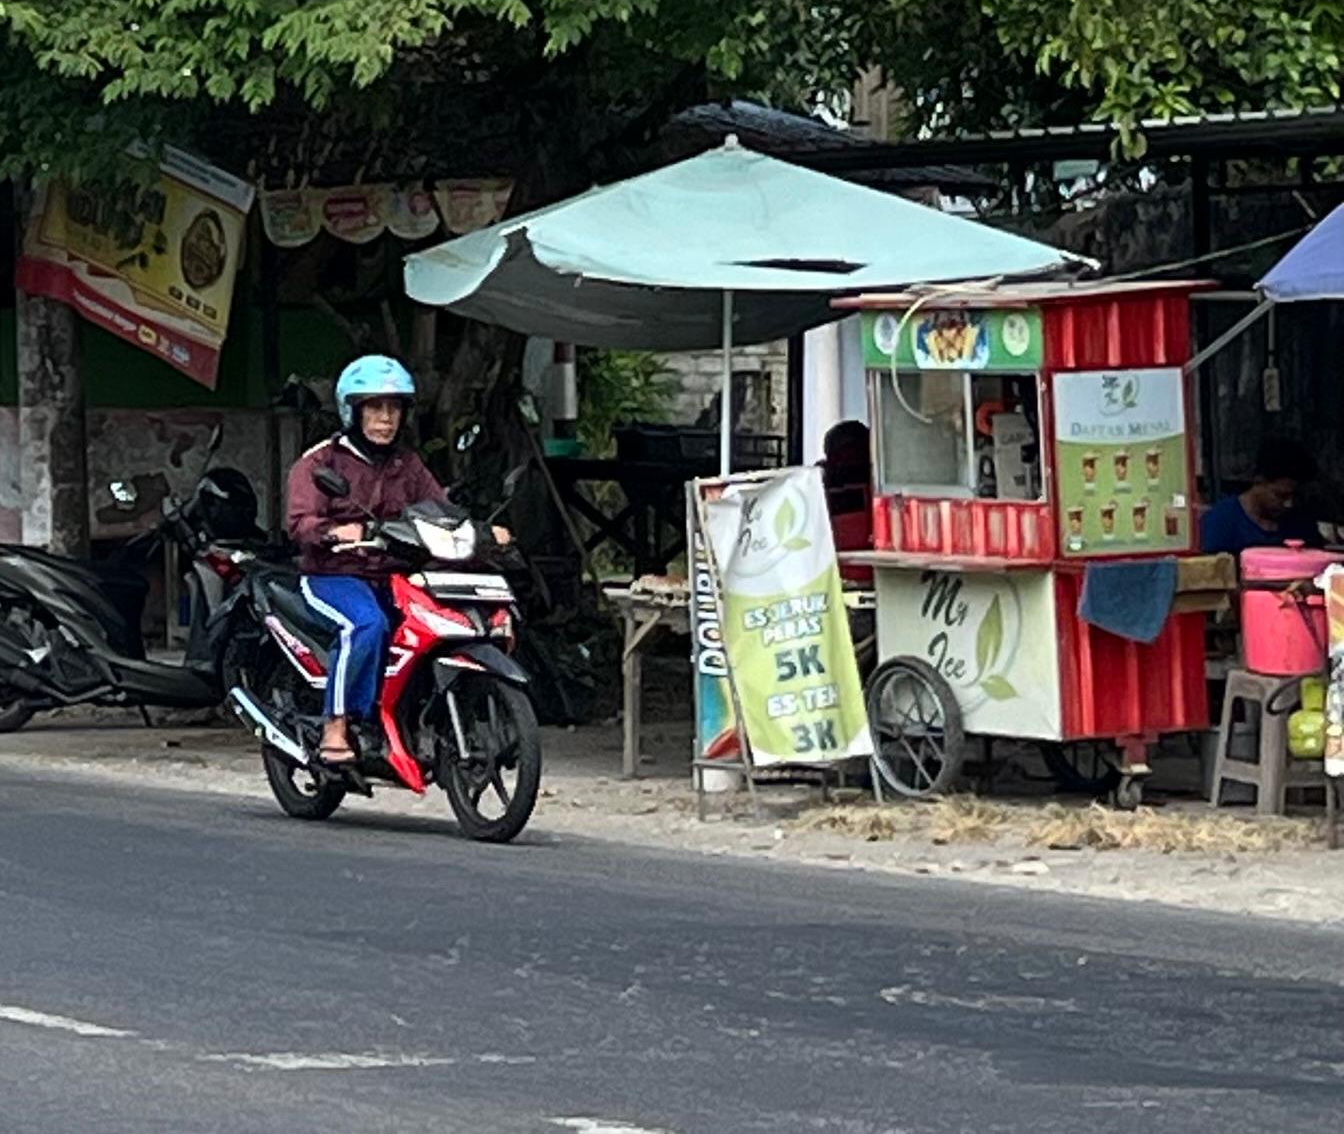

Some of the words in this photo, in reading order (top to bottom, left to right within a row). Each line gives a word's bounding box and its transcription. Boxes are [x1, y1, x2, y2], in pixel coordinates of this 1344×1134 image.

[743, 608, 769, 630] ES
[768, 594, 829, 622] JERUK
[921, 570, 968, 627] My
[762, 619, 823, 647] PERAS
[774, 645, 826, 682] 5K
[928, 631, 967, 679] Ice
[767, 693, 798, 719] ES
[792, 719, 838, 753] 3K
